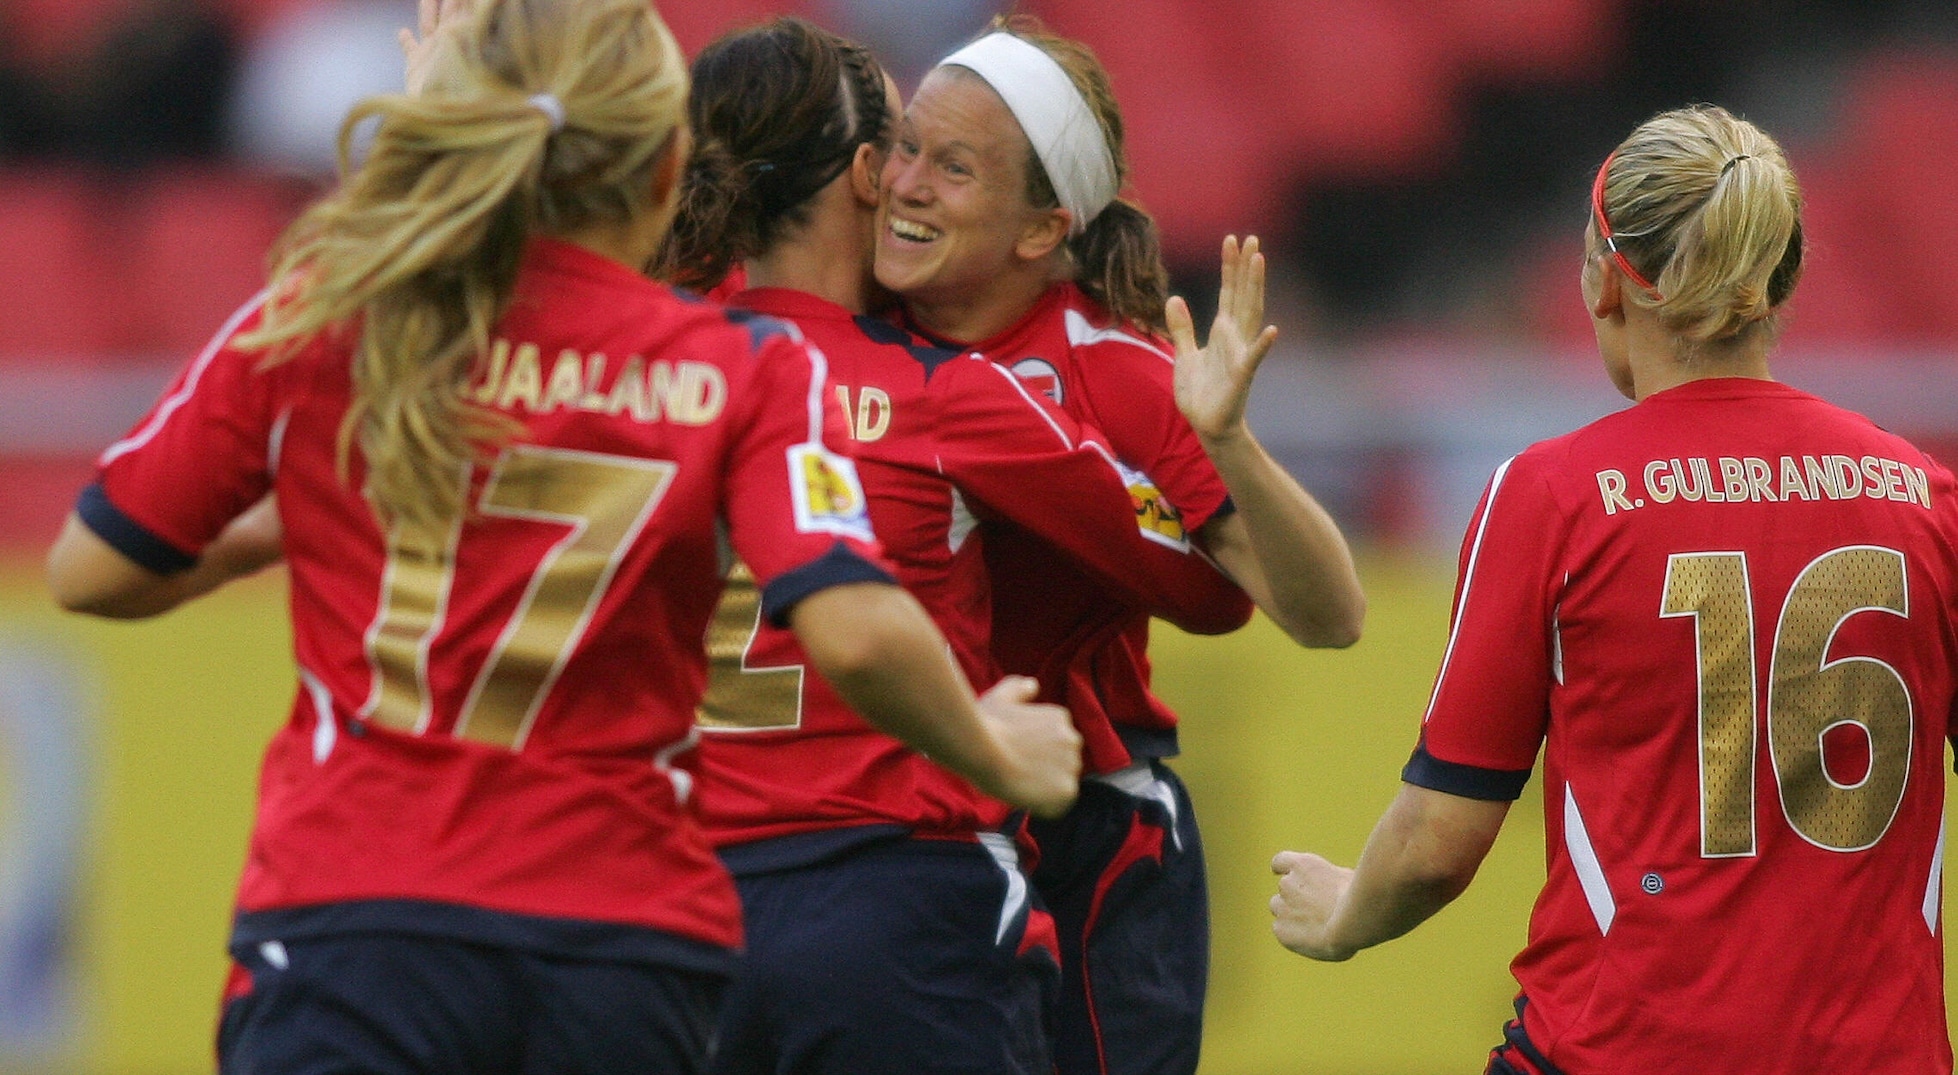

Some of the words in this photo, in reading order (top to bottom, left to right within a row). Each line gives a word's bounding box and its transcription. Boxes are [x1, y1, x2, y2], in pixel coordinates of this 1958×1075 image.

[458, 338, 727, 426] JAALAND
[357, 446, 677, 752] 17
[1659, 545, 1914, 858] 16
